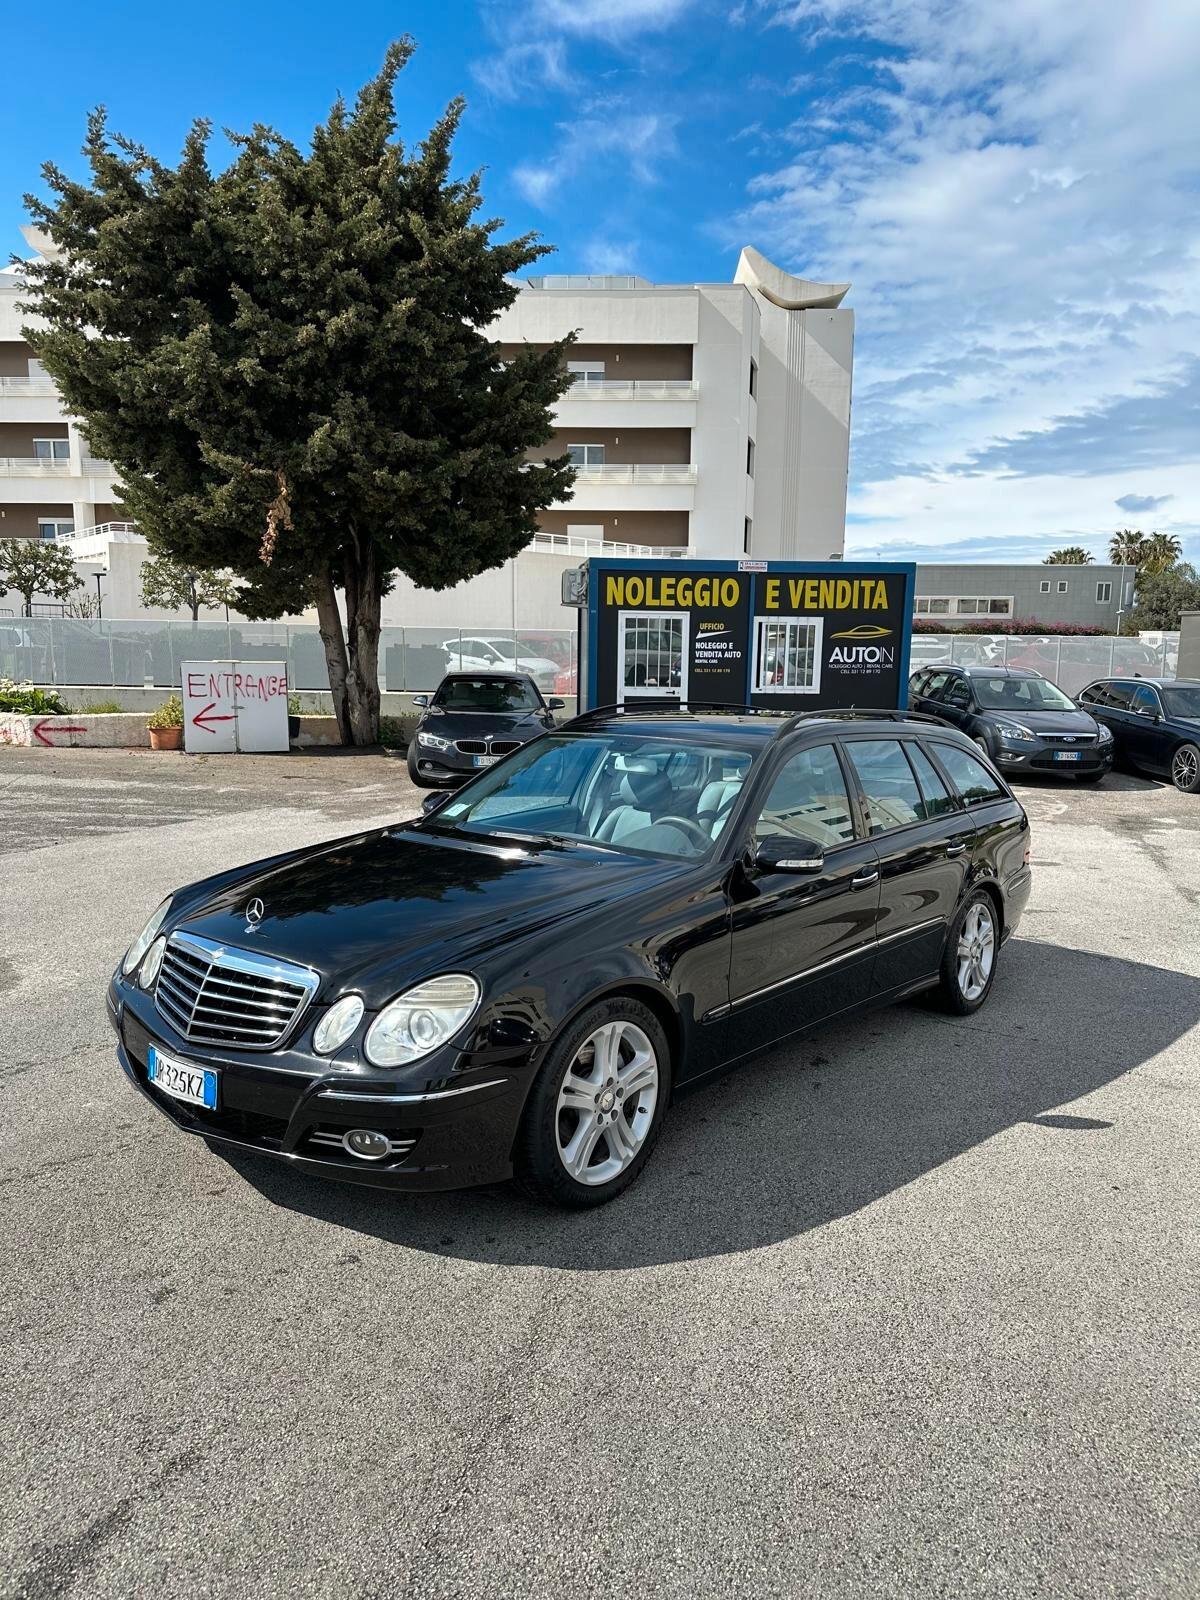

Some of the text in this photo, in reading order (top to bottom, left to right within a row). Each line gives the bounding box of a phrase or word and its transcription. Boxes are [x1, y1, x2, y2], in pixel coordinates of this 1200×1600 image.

[606, 576, 889, 609] NOLEGGIO E VENDITA
[154, 1056, 204, 1099] DR325KZ
